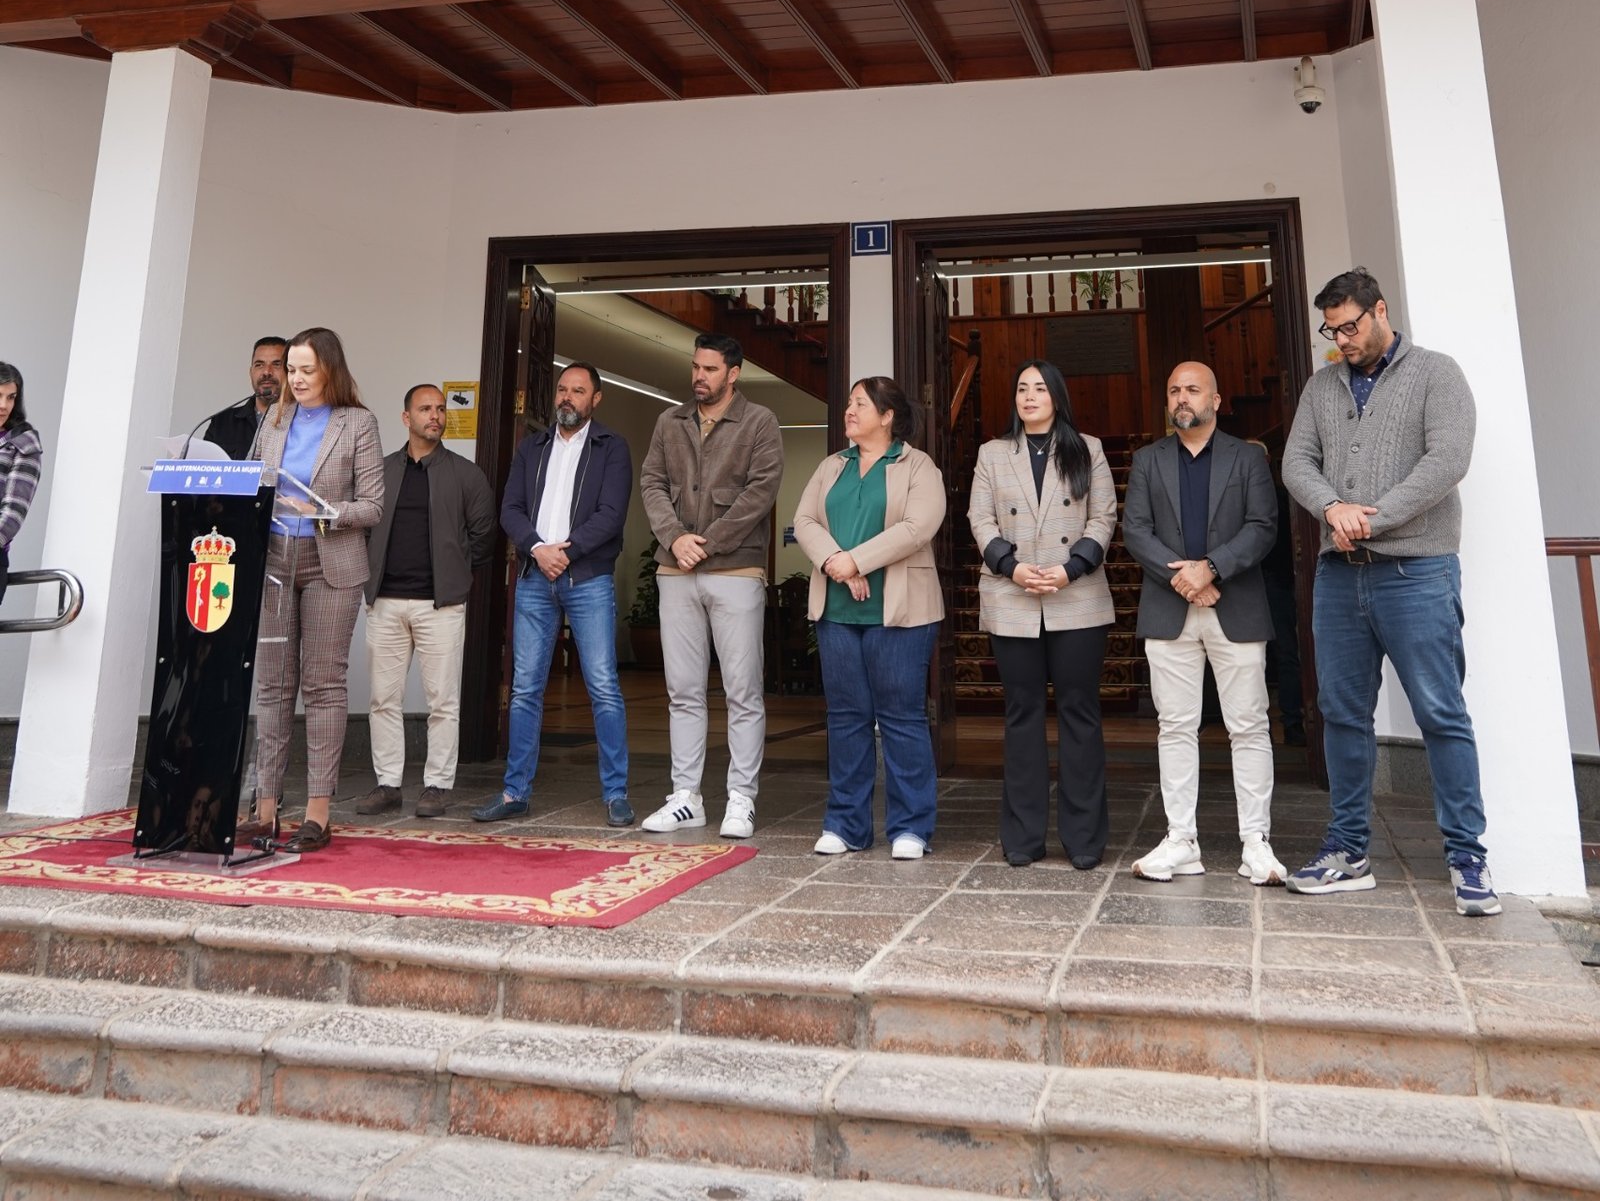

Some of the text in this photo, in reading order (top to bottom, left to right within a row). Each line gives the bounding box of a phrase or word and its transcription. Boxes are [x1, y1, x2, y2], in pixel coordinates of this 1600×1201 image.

[867, 230, 875, 247] 1
[176, 465, 223, 473] INTERNACIONAL
[232, 465, 241, 473] LA
[242, 466, 261, 474] MUJER
